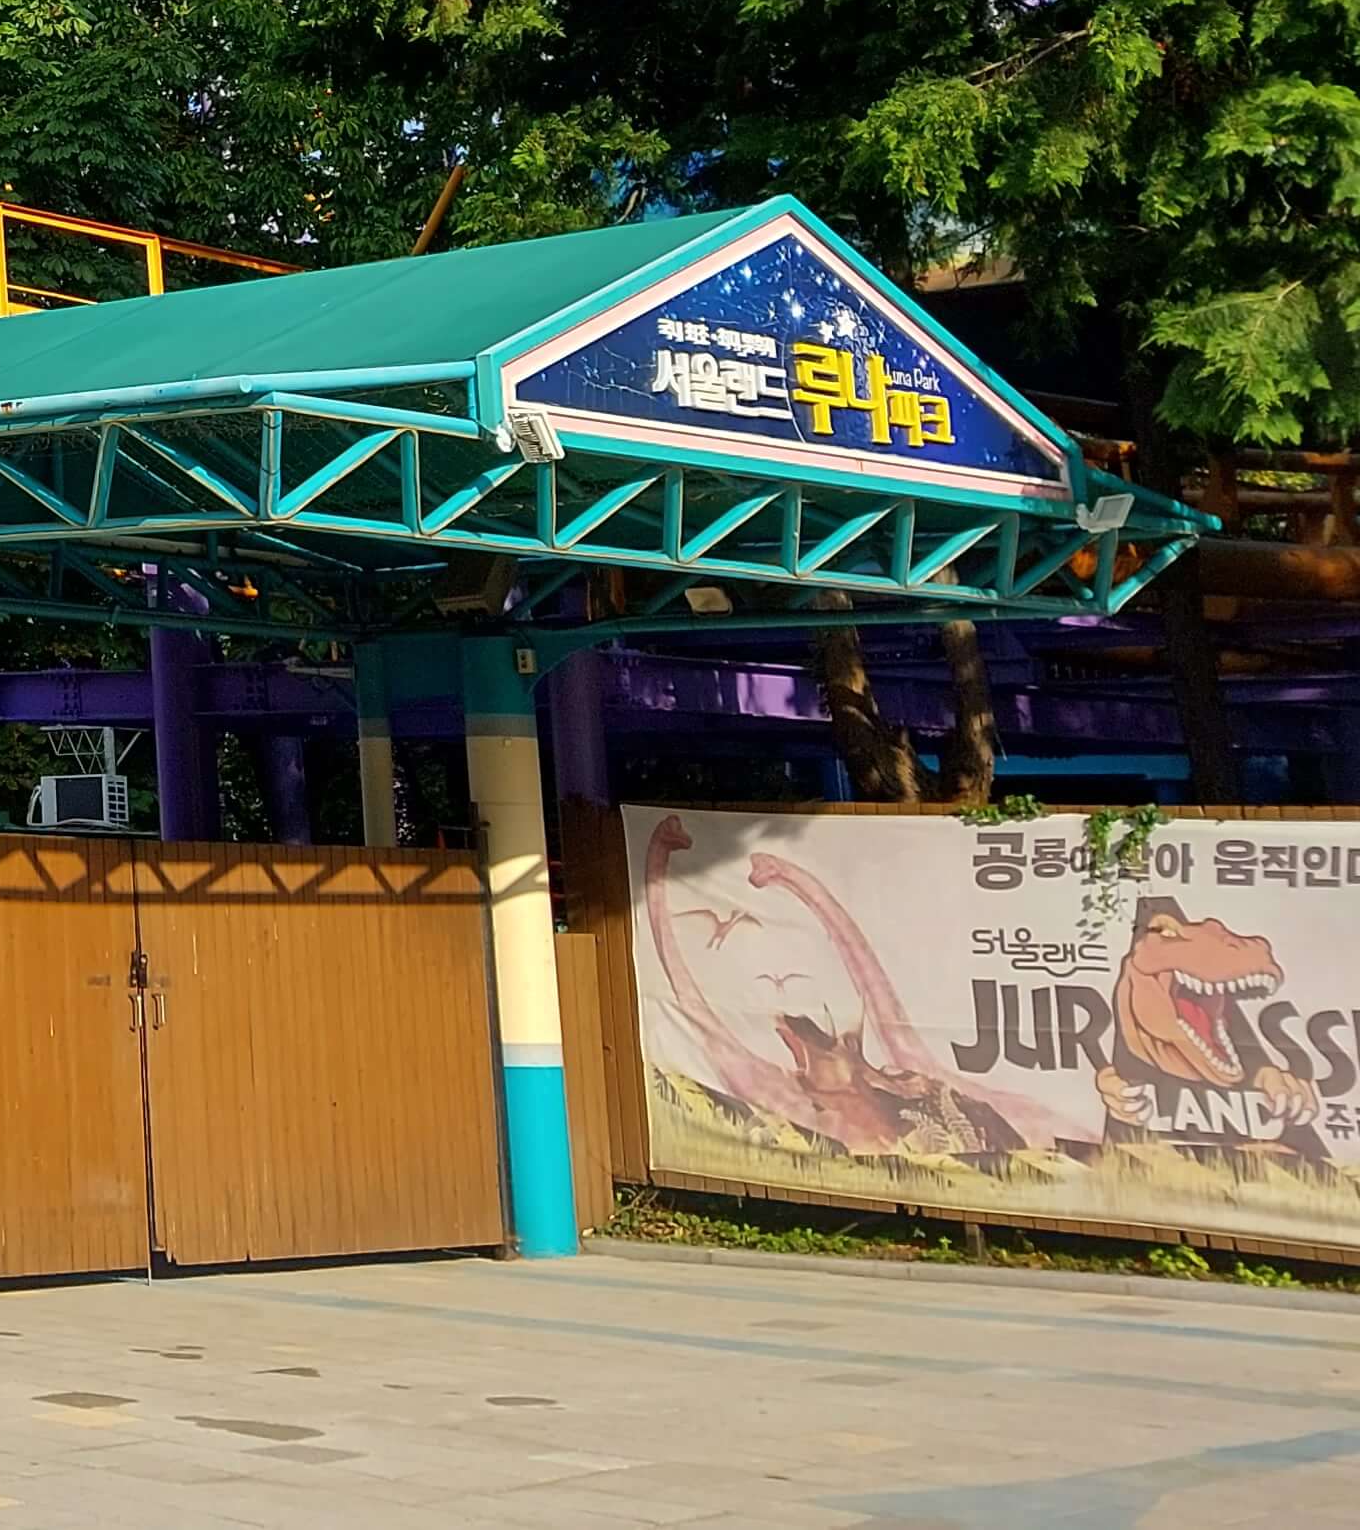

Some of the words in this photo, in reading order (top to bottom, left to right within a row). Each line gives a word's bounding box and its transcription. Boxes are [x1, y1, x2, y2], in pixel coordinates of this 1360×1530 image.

[652, 349, 793, 420] 서울랜드
[793, 341, 956, 448] 루나파크
[913, 367, 942, 393] Park
[971, 926, 1111, 977] 서울랜드
[950, 897, 1360, 1160] JURASS
[1143, 1083, 1285, 1142] LAND
[1324, 1102, 1360, 1141] 쥬
